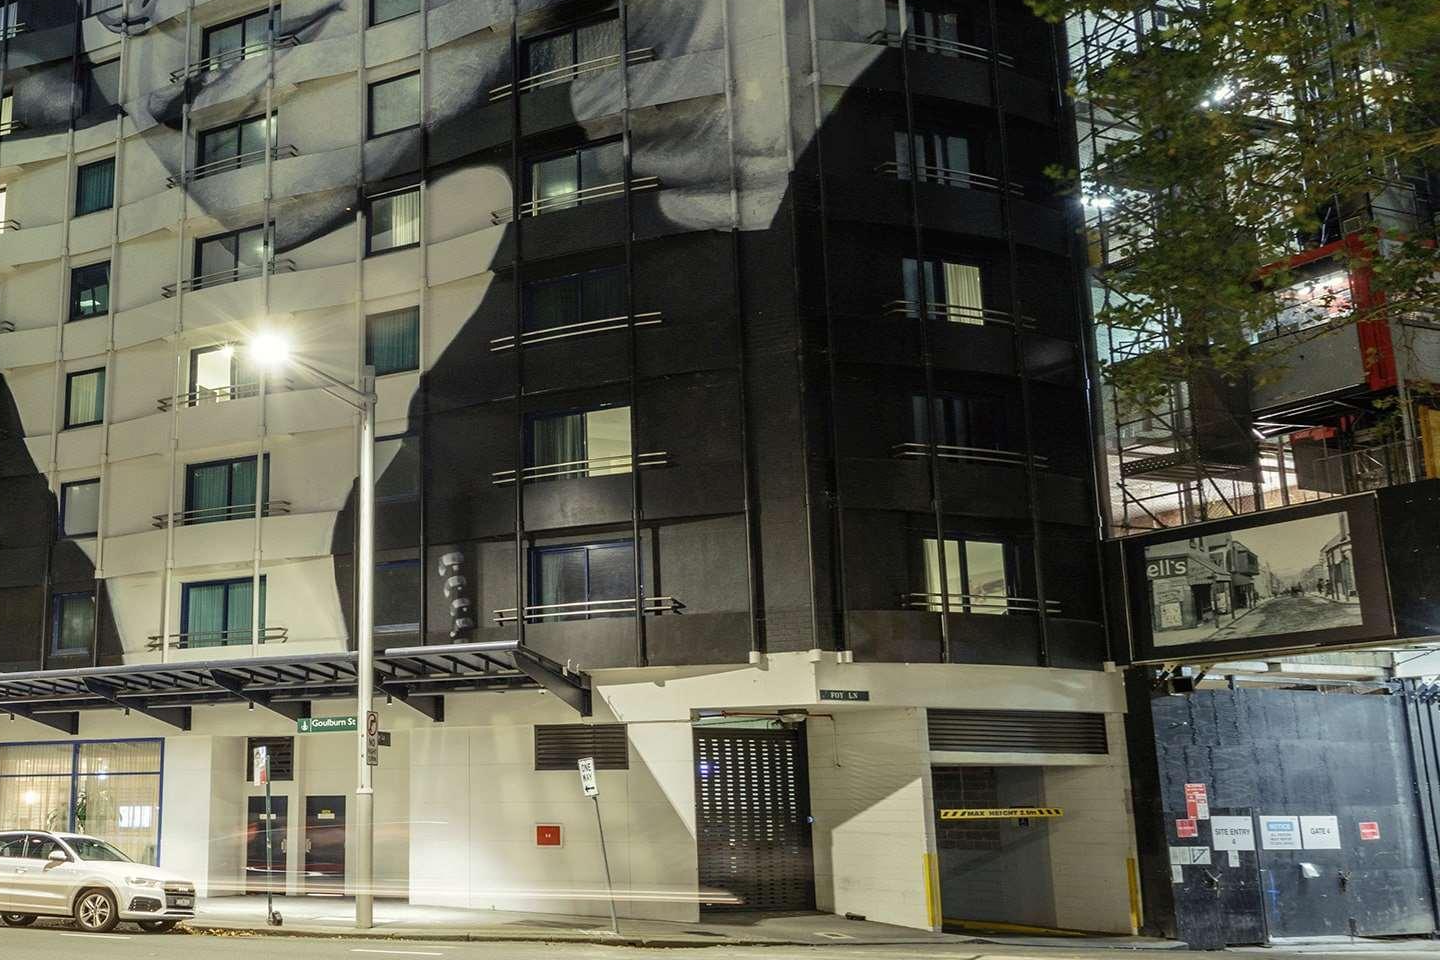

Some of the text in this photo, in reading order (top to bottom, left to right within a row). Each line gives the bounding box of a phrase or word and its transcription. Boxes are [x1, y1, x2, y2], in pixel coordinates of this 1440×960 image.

[1146, 559, 1187, 577] ell's
[311, 718, 347, 728] Goulburn
[581, 762, 592, 772] ONE
[1215, 828, 1250, 836] SITE ENTRY
[1310, 827, 1326, 835] GATE
